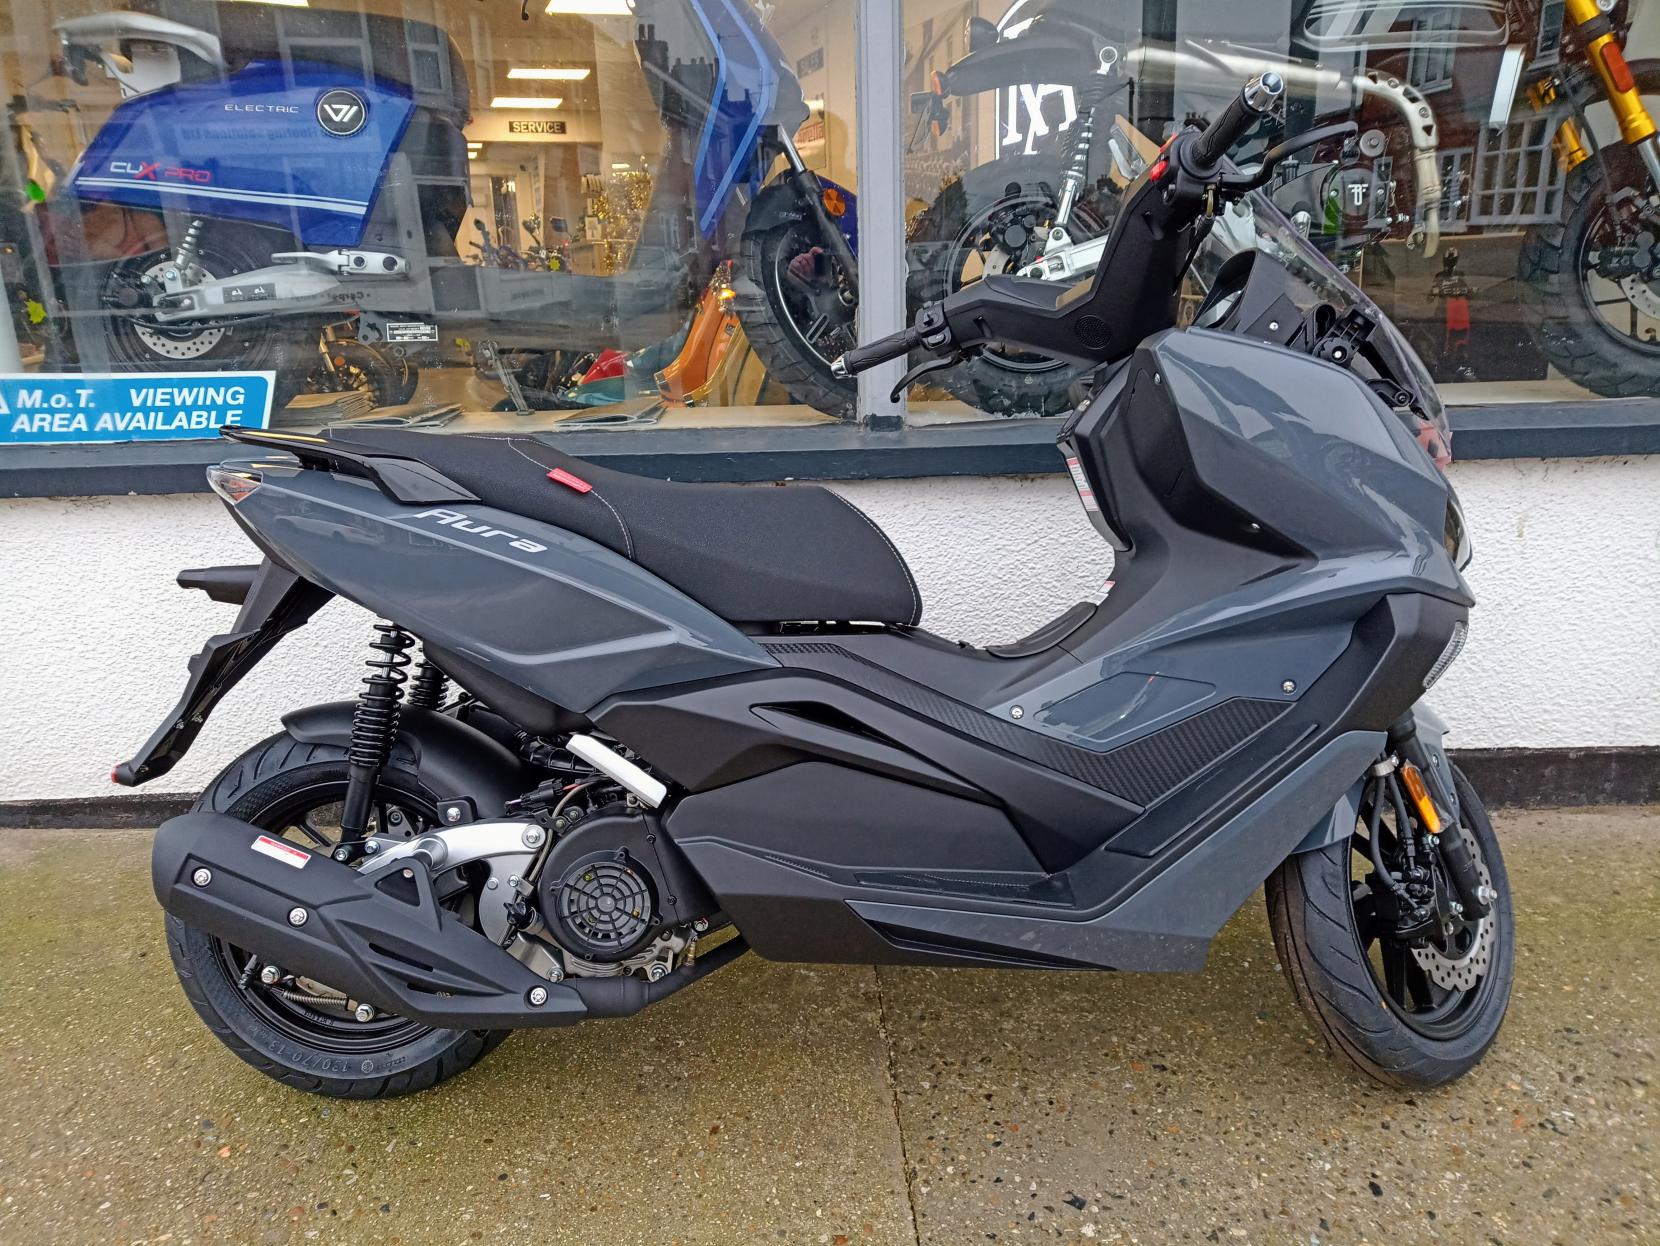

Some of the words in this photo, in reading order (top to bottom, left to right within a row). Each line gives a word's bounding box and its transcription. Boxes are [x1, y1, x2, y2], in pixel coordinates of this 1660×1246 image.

[224, 103, 300, 114] ELECTRIC
[512, 121, 562, 133] SERVICE
[109, 160, 161, 181] CUX
[164, 166, 211, 183] PRO
[17, 389, 95, 408] M.o.T.
[130, 386, 246, 407] VIEWING
[10, 413, 88, 433] AREA
[93, 410, 243, 432] AVAILABLE
[412, 508, 548, 553] Aura
